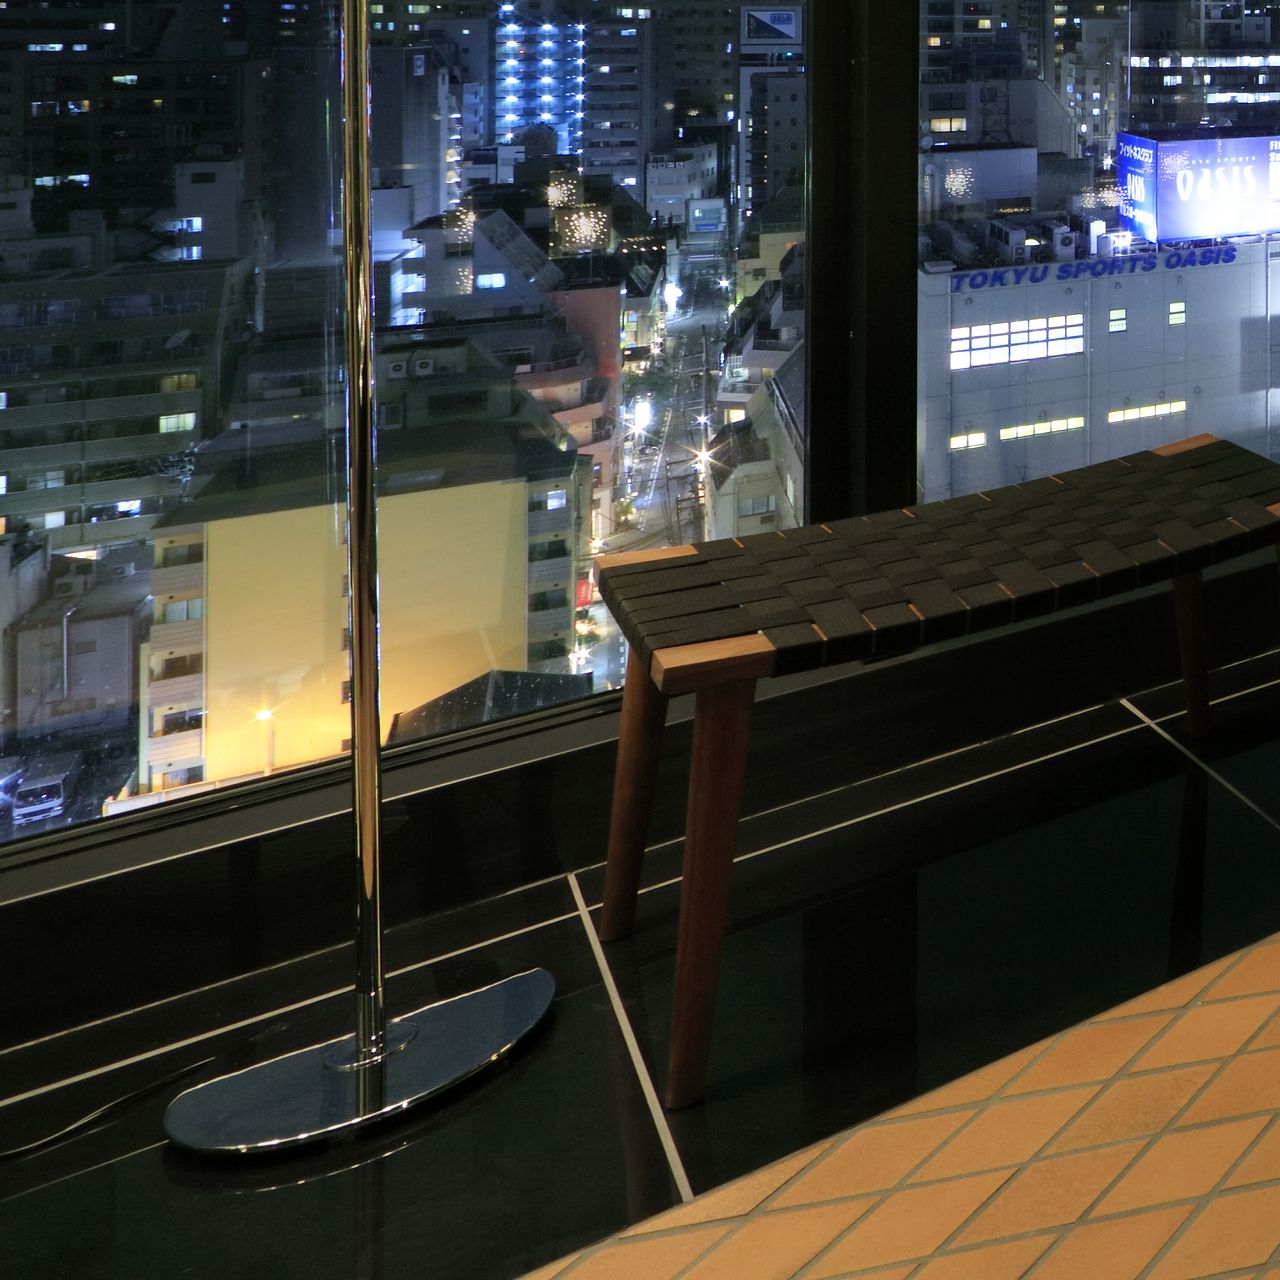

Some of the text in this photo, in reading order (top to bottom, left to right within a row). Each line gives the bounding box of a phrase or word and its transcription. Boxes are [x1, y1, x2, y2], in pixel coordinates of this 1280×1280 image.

[1119, 142, 1153, 163] フィットネスクラブ
[951, 246, 1238, 293] TOKYU SPORTS OASIS
